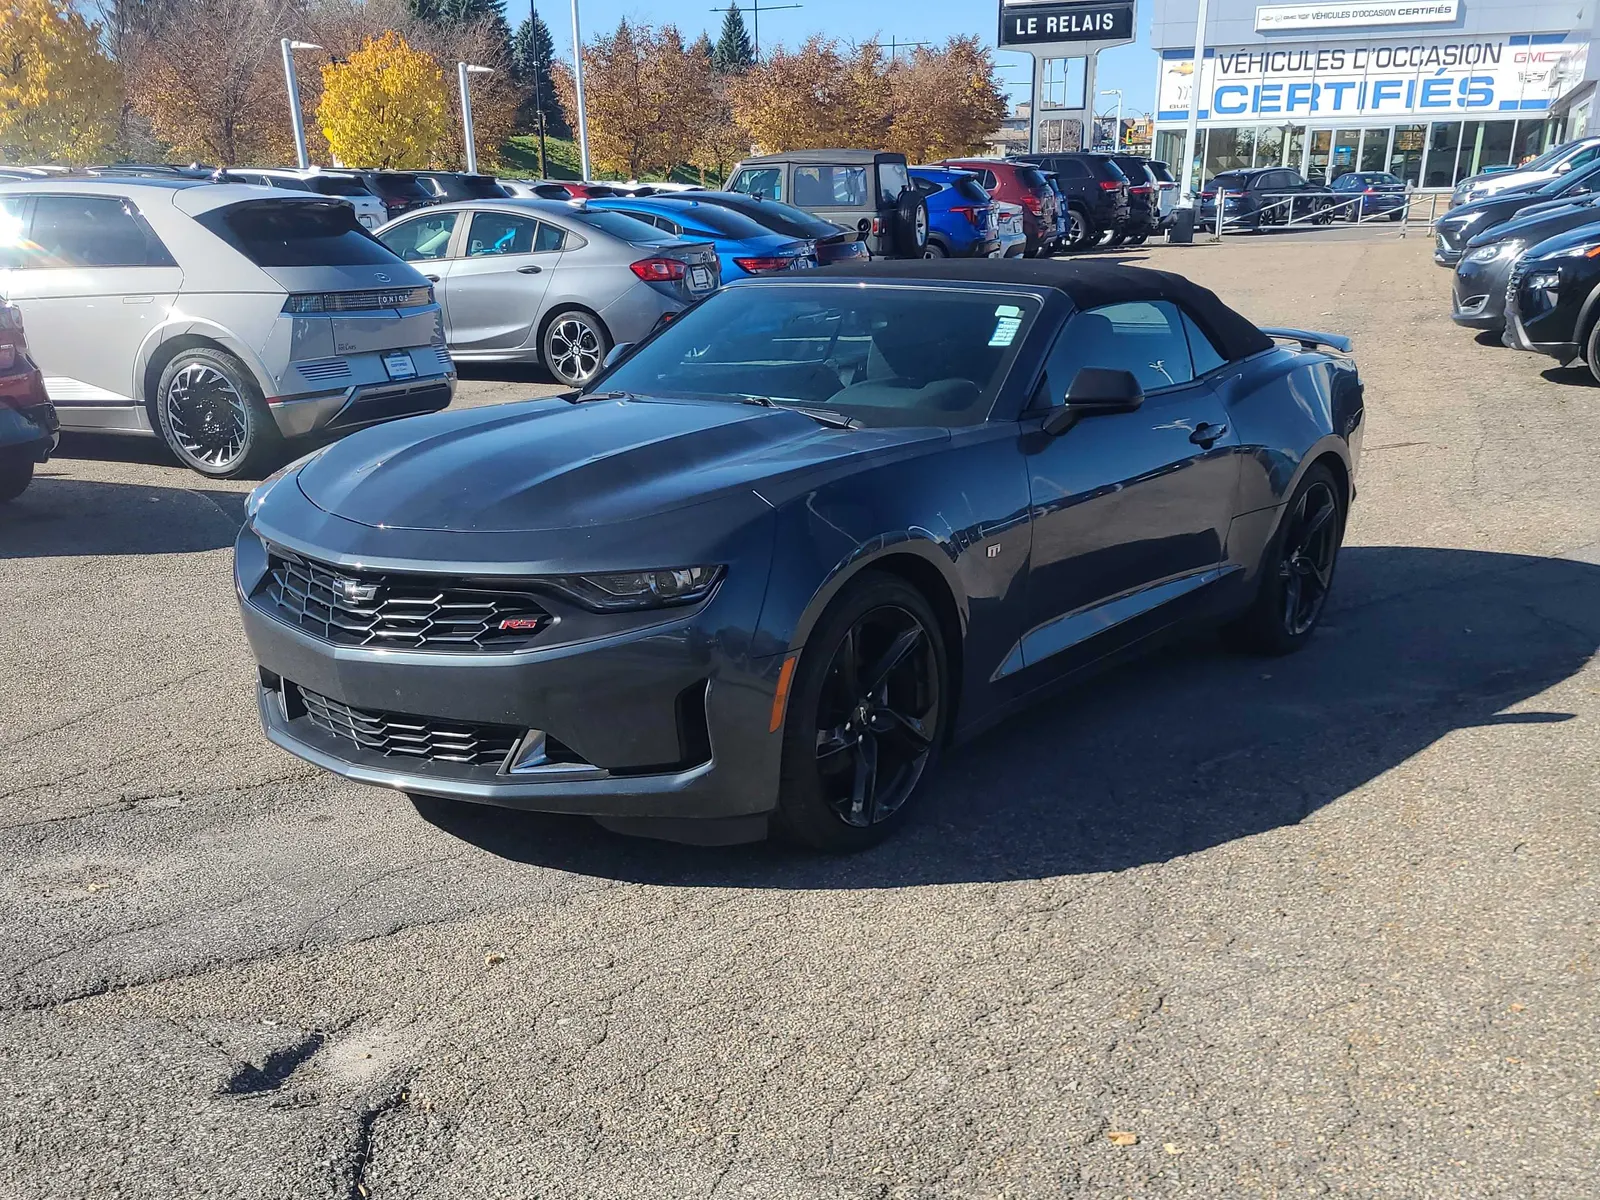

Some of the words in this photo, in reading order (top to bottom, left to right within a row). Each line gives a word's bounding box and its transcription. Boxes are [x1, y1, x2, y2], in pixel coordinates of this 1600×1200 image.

[1312, 11, 1351, 20] VÉHICULES
[1352, 9, 1397, 18] D'OCCASION
[1398, 4, 1452, 16] CERTIFIÉS
[1016, 18, 1038, 35] LE
[1046, 13, 1114, 33] RELAIS
[1219, 48, 1346, 74] VÉHICULES
[1352, 42, 1503, 69] D'OCCASION
[1513, 51, 1568, 63] GMC
[1213, 67, 1495, 114] CERTIFIÉS
[499, 619, 537, 629] RS
